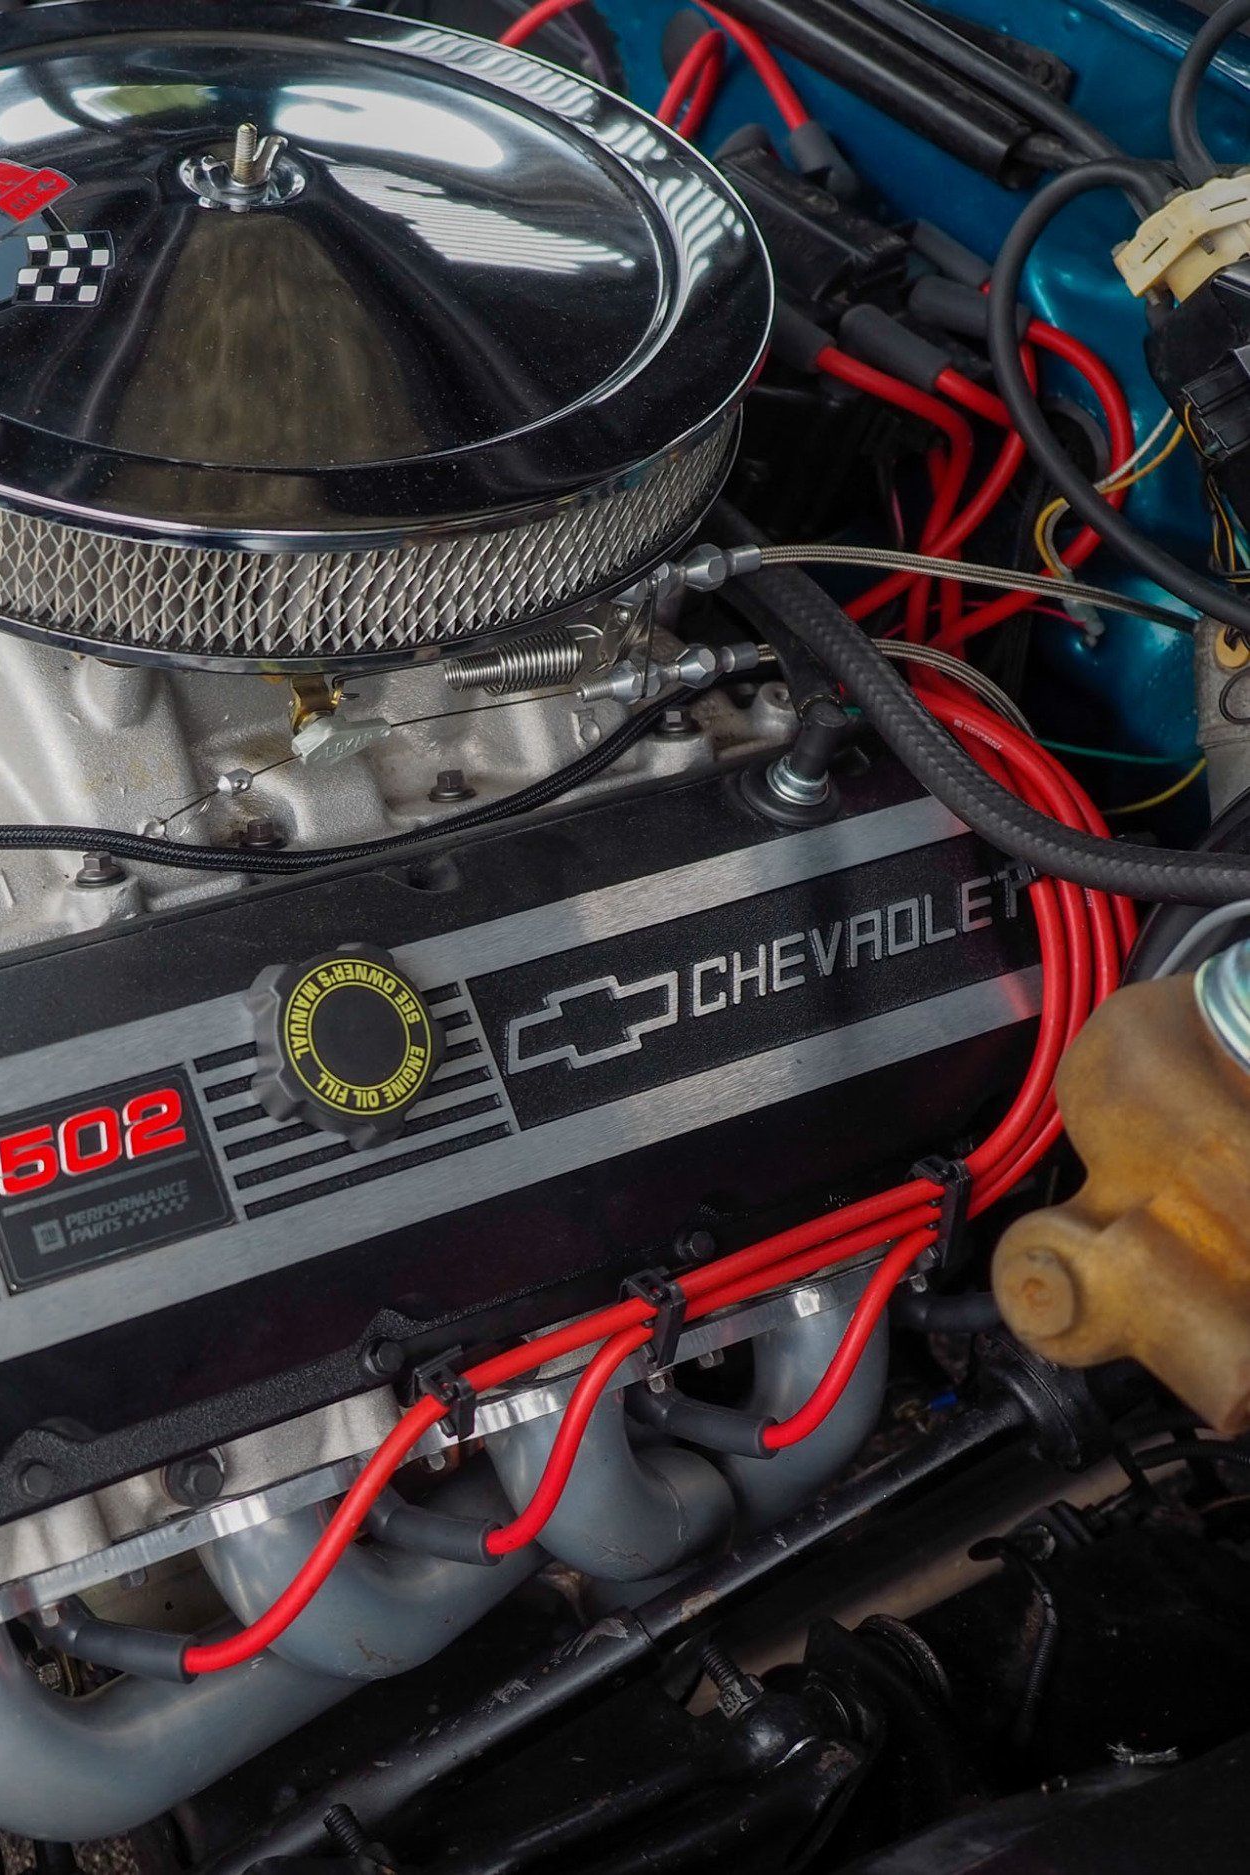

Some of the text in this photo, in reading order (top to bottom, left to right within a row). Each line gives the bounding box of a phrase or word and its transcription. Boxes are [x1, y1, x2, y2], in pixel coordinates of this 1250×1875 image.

[692, 867, 1022, 1018] CHEVROLET
[290, 963, 421, 1060] SEE OWNER'S MANUAL
[316, 1044, 426, 1108] ENGINE OIL FILL
[65, 1179, 190, 1229] PERFORMANCE
[69, 1216, 123, 1245] PARTS
